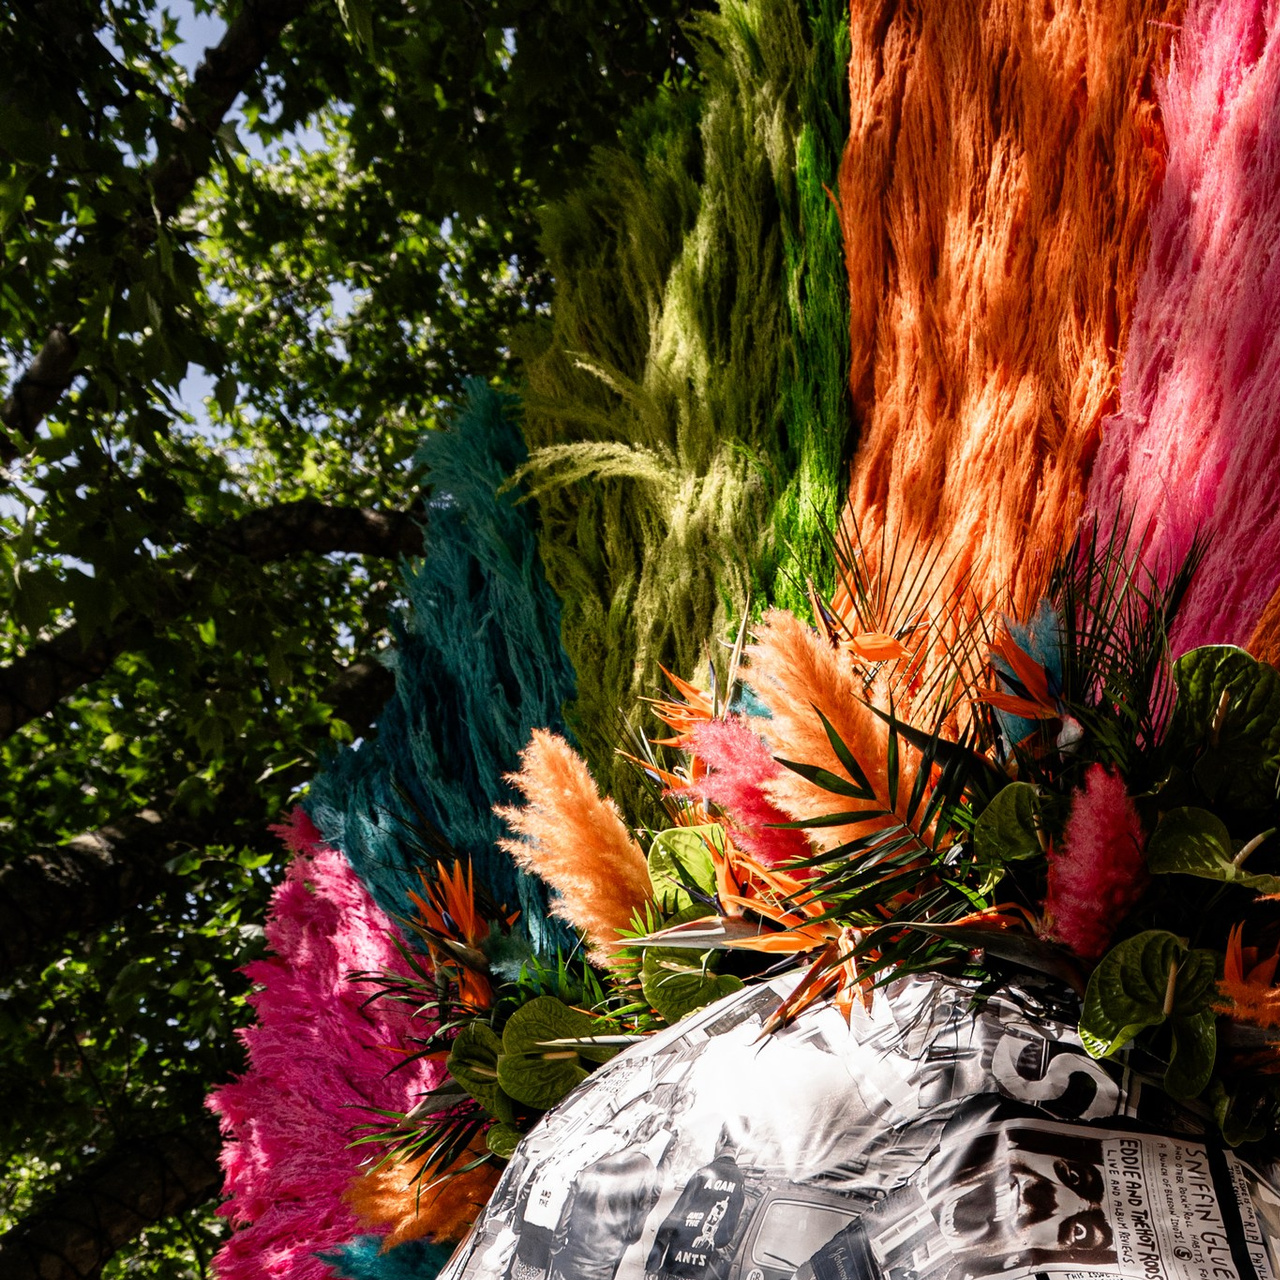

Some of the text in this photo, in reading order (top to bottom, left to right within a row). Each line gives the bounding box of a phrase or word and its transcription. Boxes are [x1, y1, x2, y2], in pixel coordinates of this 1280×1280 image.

[1107, 1149, 1118, 1176] LIVE
[1119, 1138, 1142, 1180] EDDIE
[1157, 1152, 1169, 1177] BUNCH
[1174, 1145, 1184, 1162] AND
[1174, 1162, 1185, 1184] OTHER
[1110, 1179, 1121, 1197] AND
[1125, 1181, 1143, 1207] AND
[1113, 1201, 1129, 1229] ALBUM
[674, 1250, 707, 1267] ANTS
